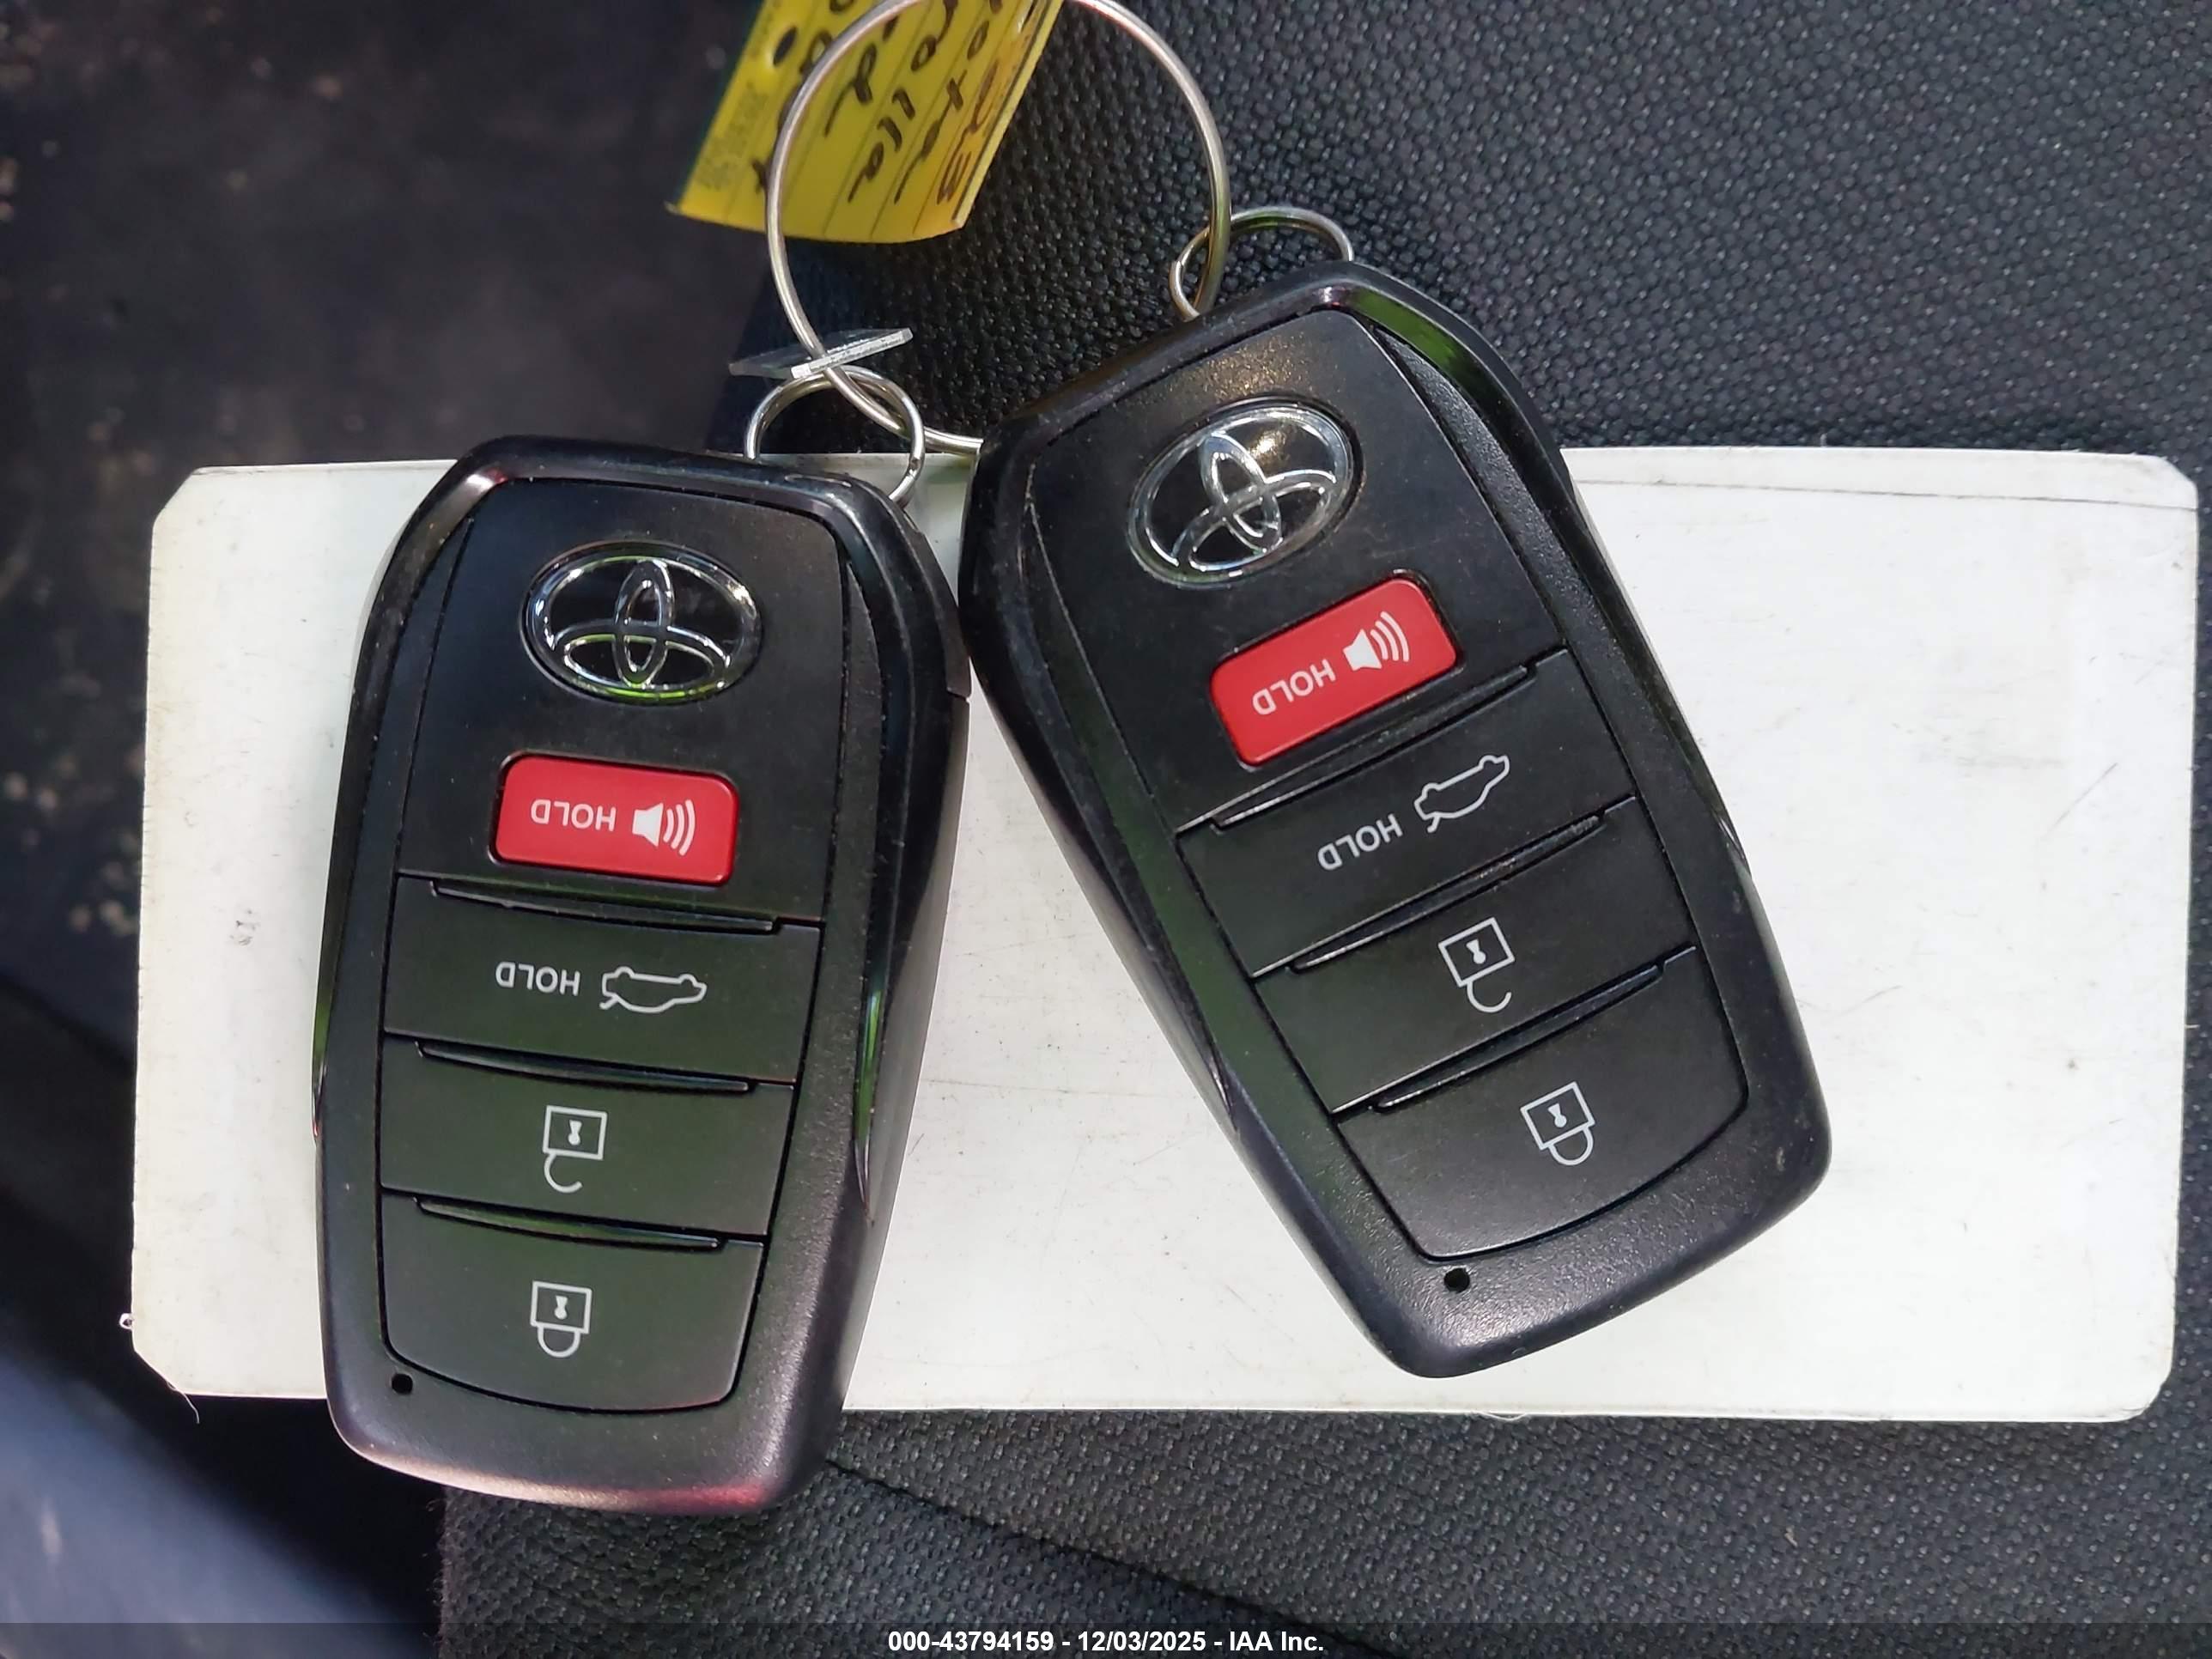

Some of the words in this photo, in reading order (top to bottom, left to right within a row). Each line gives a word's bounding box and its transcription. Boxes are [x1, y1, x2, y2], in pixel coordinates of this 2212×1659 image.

[1252, 659, 1336, 715] HOLD
[531, 799, 617, 832] HOLD
[1317, 813, 1403, 871] HOLD
[495, 961, 580, 996] HOLD
